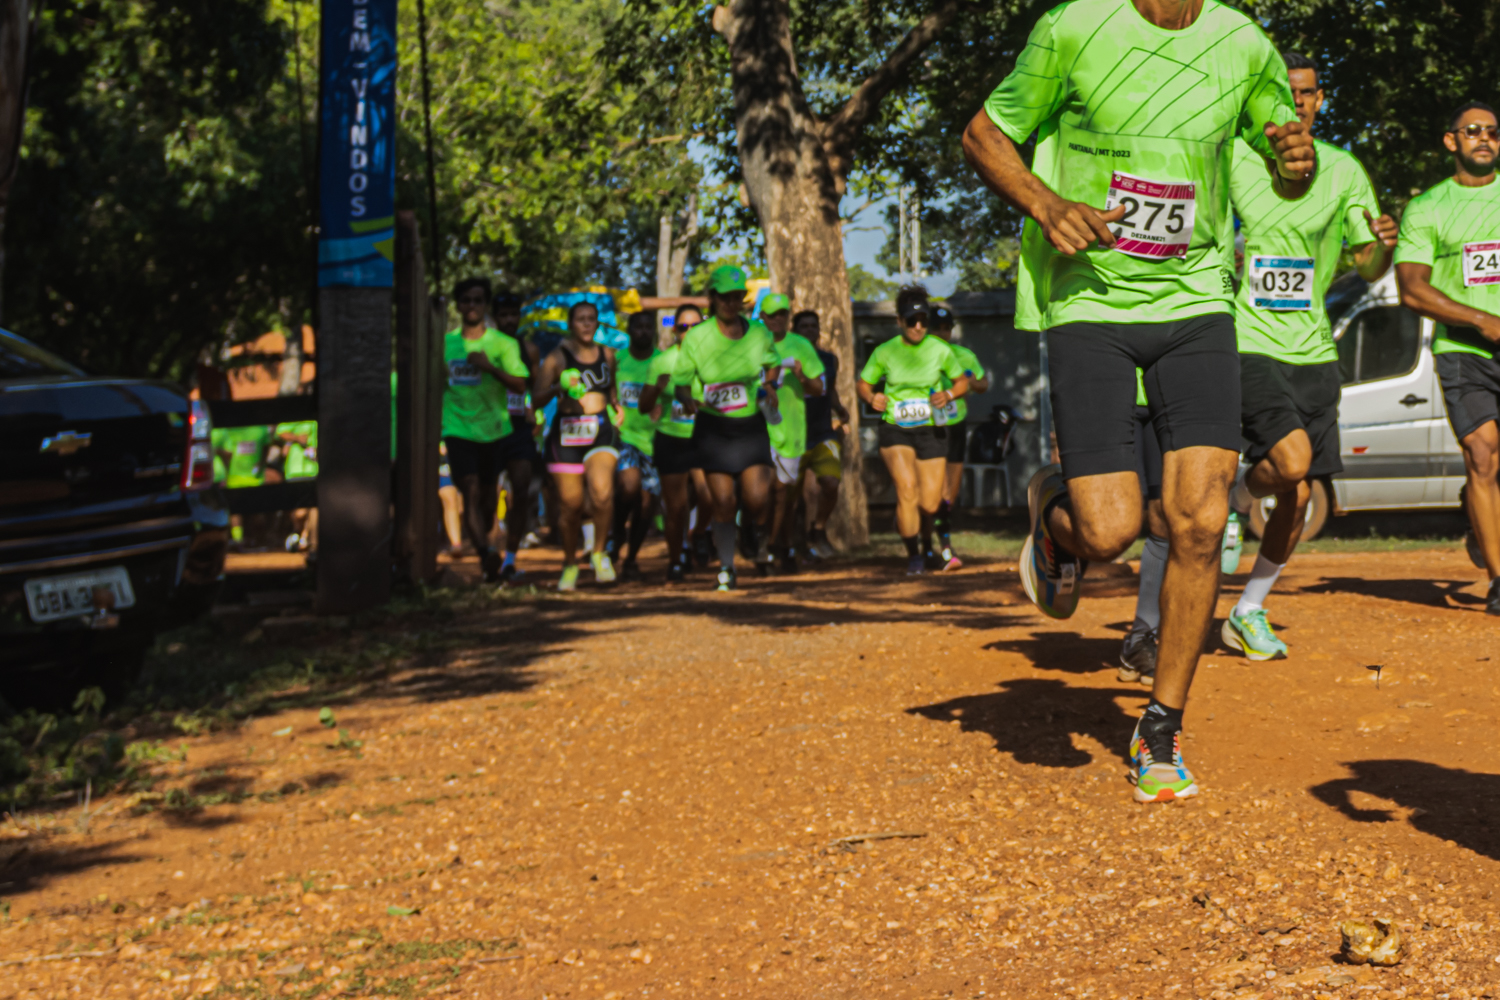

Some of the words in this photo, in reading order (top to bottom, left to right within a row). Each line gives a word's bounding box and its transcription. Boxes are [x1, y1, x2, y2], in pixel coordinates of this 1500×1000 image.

[1113, 196, 1185, 234] 275
[1262, 271, 1306, 292] 032
[711, 386, 741, 404] 228
[900, 407, 925, 419] 030
